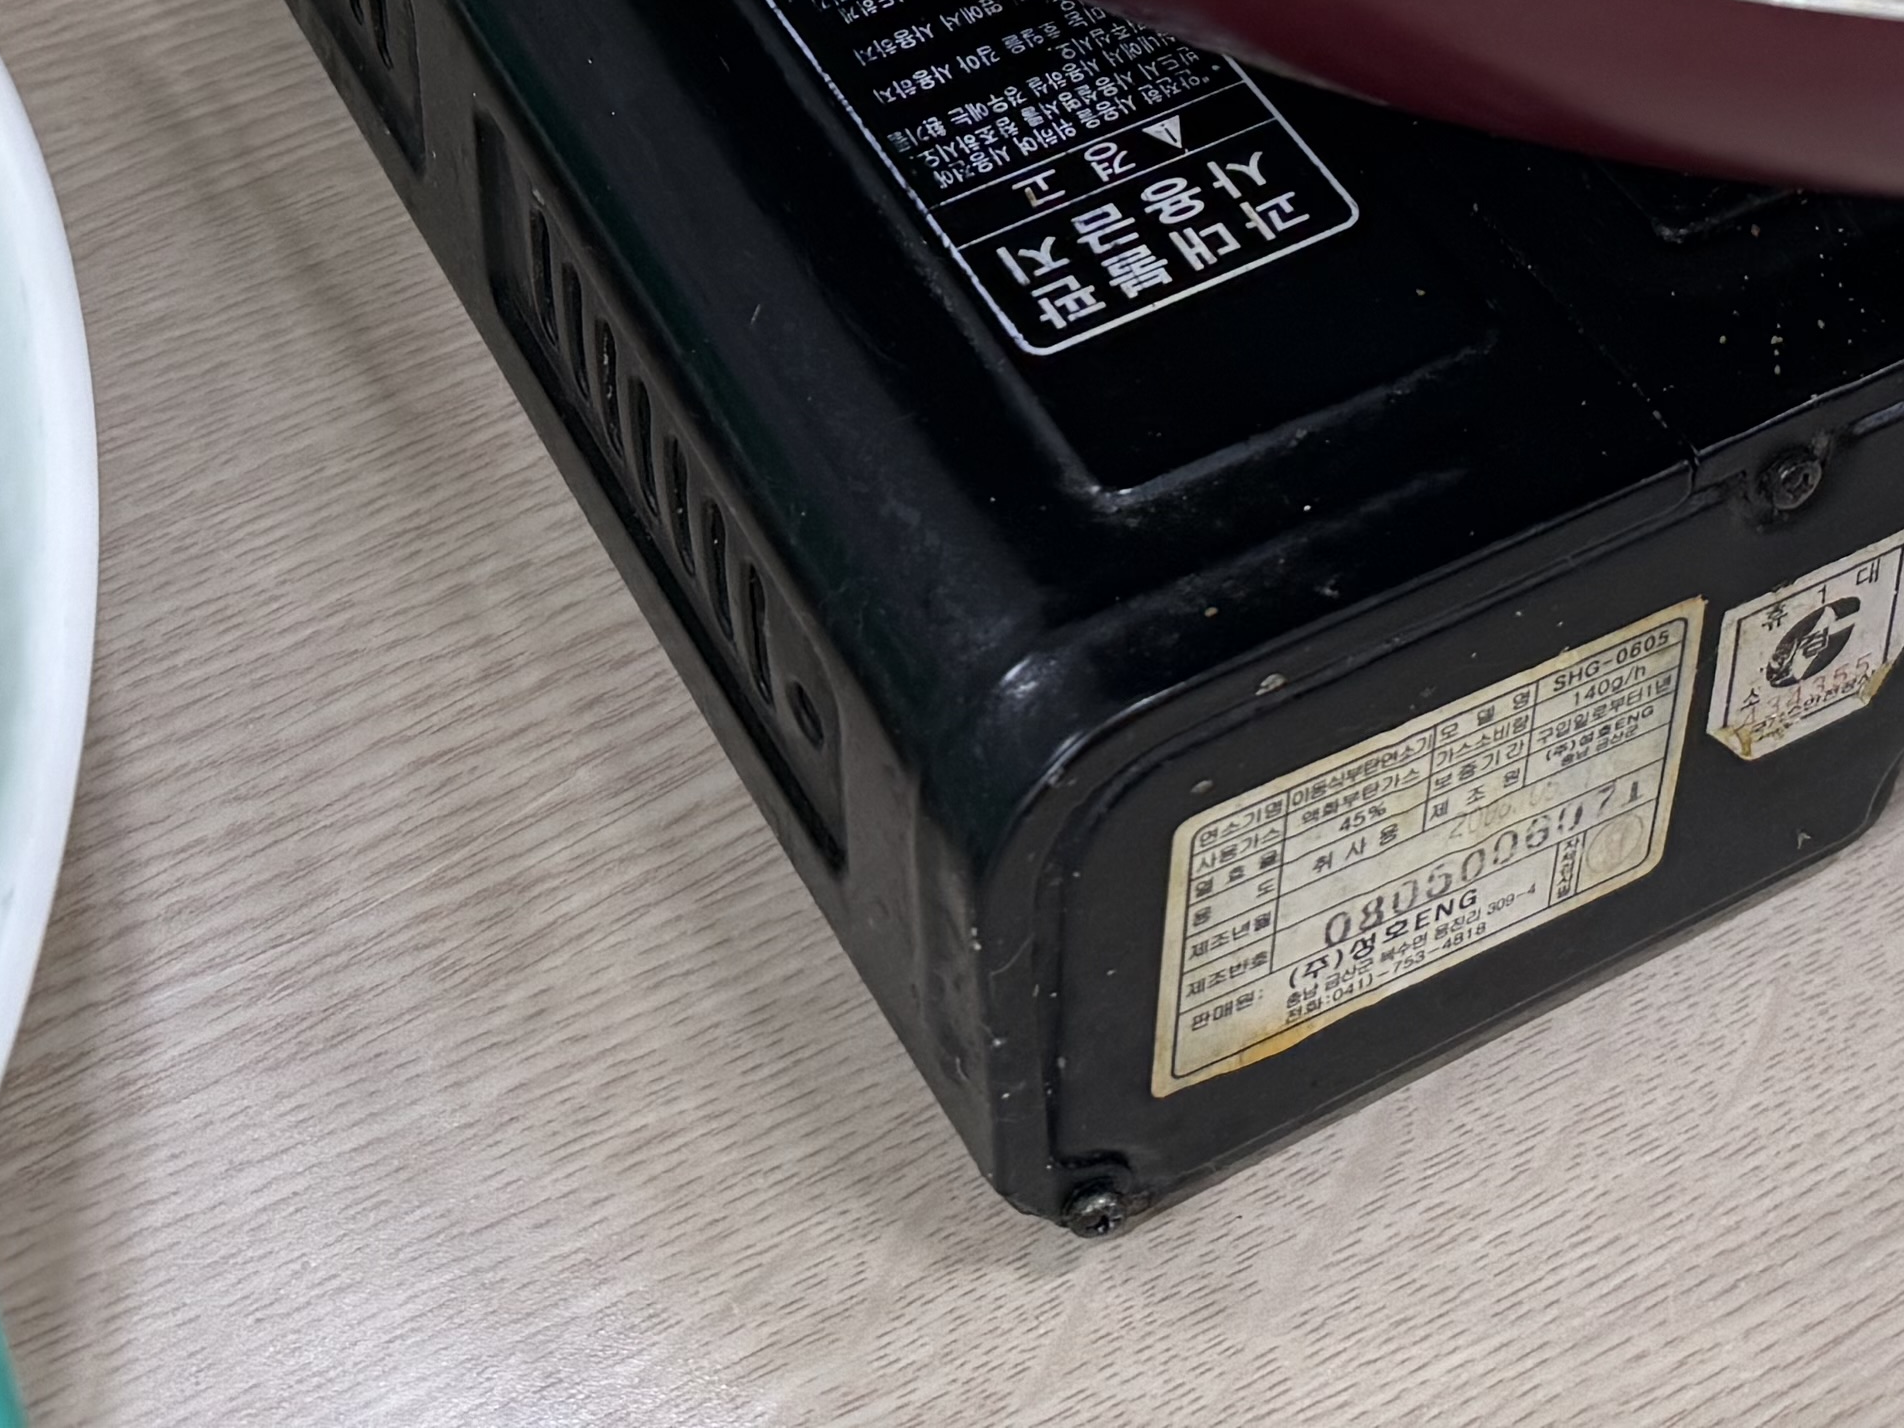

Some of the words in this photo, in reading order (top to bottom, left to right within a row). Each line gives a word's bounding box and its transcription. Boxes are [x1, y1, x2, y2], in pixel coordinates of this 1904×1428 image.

[854, 22, 934, 66] 사용하지
[955, 44, 1000, 73] 감아
[1137, 46, 1198, 80] 반드시
[872, 62, 953, 103] 사용하지
[1020, 70, 1133, 127] 사용설명서를
[1026, 57, 1099, 97] 사용하실
[946, 85, 1027, 125] 경우에는
[1075, 94, 1137, 129] 사용을
[1011, 117, 1077, 156] 위하여
[995, 150, 1267, 285] 사용금지
[1030, 190, 1310, 329] 과대불판
[1551, 627, 1671, 693] SHG-0605
[1572, 663, 1647, 707] 140g/h
[1435, 712, 1530, 768] 가스소비량
[1431, 738, 1525, 793] 보증기간
[1337, 799, 1387, 832] 45%
[1194, 826, 1283, 874] 사용가스
